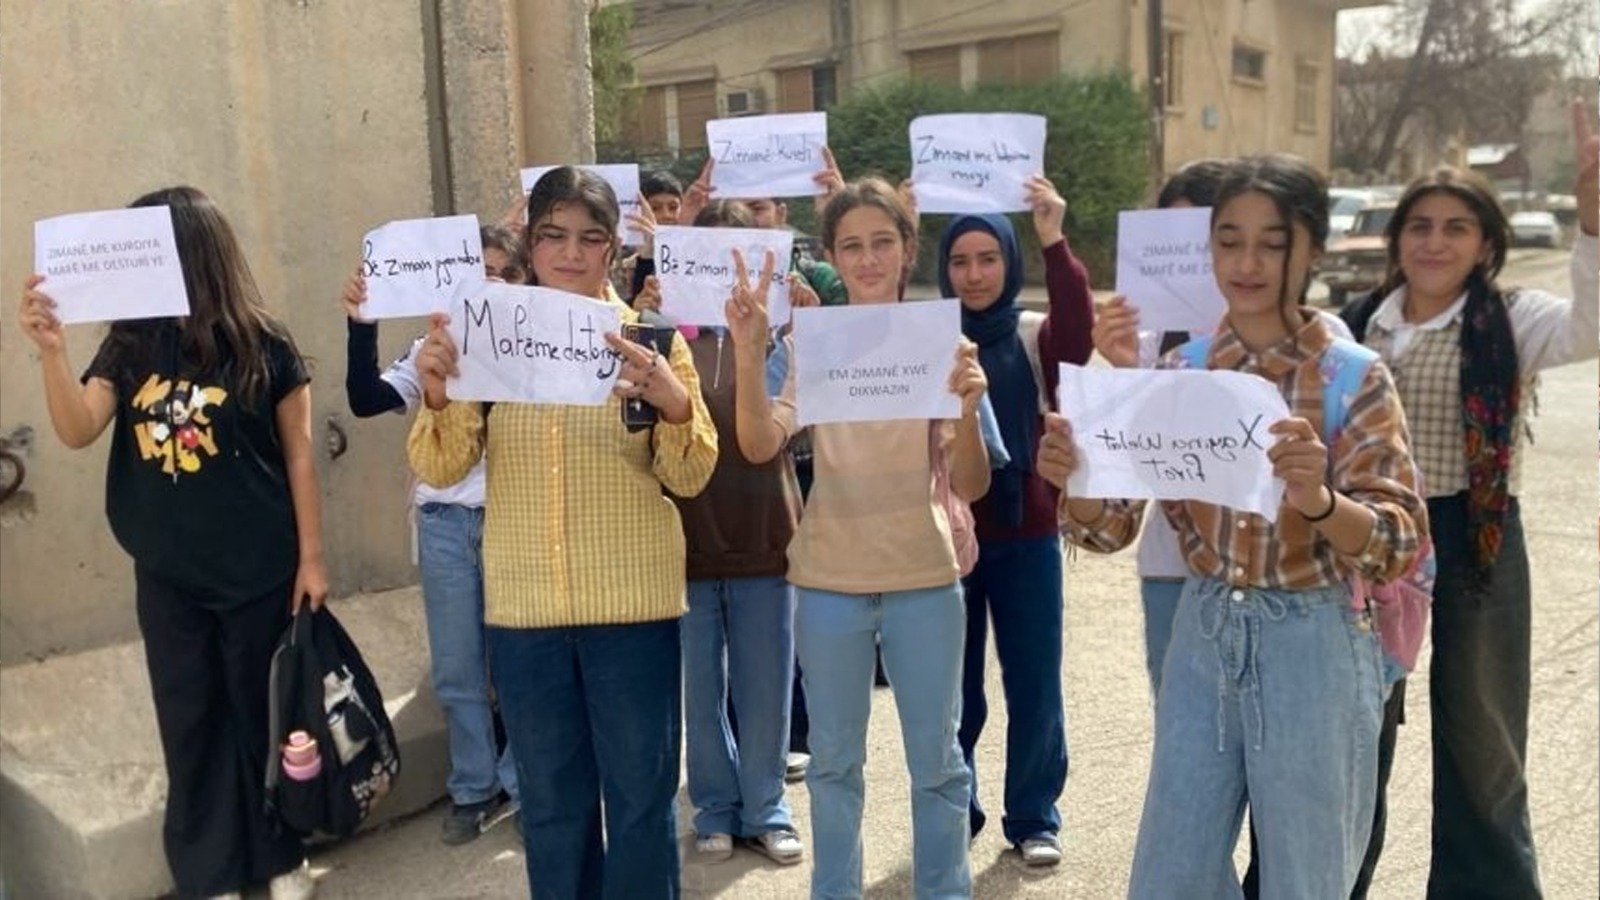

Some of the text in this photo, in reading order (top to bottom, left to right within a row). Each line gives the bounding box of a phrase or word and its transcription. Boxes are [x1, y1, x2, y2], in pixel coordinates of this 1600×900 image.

[91, 242, 111, 254] ME
[829, 369, 849, 380] EM
[902, 364, 928, 375] XWE
